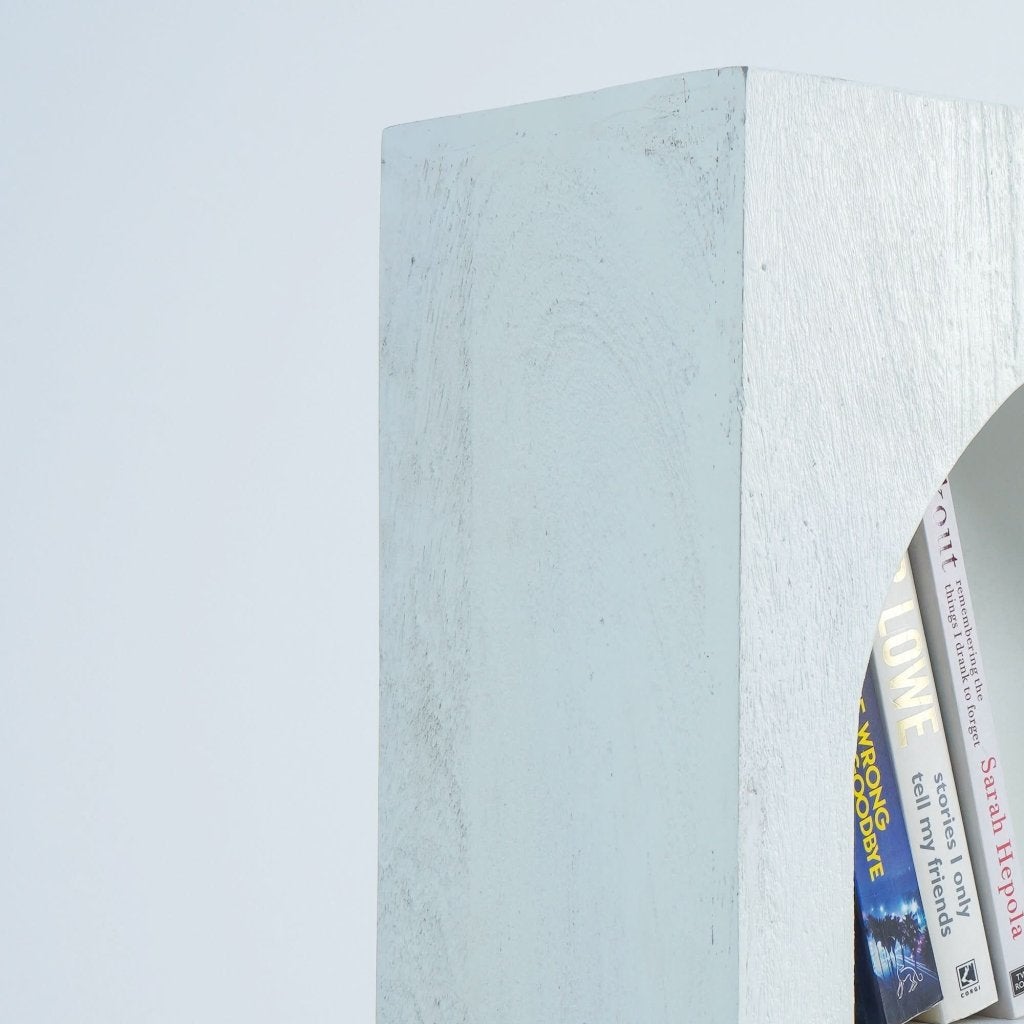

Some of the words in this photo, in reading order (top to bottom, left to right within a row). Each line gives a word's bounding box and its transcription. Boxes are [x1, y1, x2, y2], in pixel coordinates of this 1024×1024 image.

[944, 584, 958, 629] things
[953, 631, 962, 639] I
[956, 579, 978, 676] remembering
[975, 676, 983, 701] the
[878, 599, 940, 748] LOWE
[956, 641, 970, 684] drank
[964, 683, 971, 701] to
[967, 704, 981, 747] forget
[858, 720, 890, 832] WRONG
[912, 772, 931, 811] tell
[934, 772, 957, 850] stories
[919, 816, 935, 851] my
[981, 756, 1007, 835] Sarah
[995, 838, 1024, 941] Hepola
[950, 854, 962, 865] I
[928, 857, 953, 938] friends
[953, 871, 971, 918] only
[960, 985, 981, 998] CORGI
